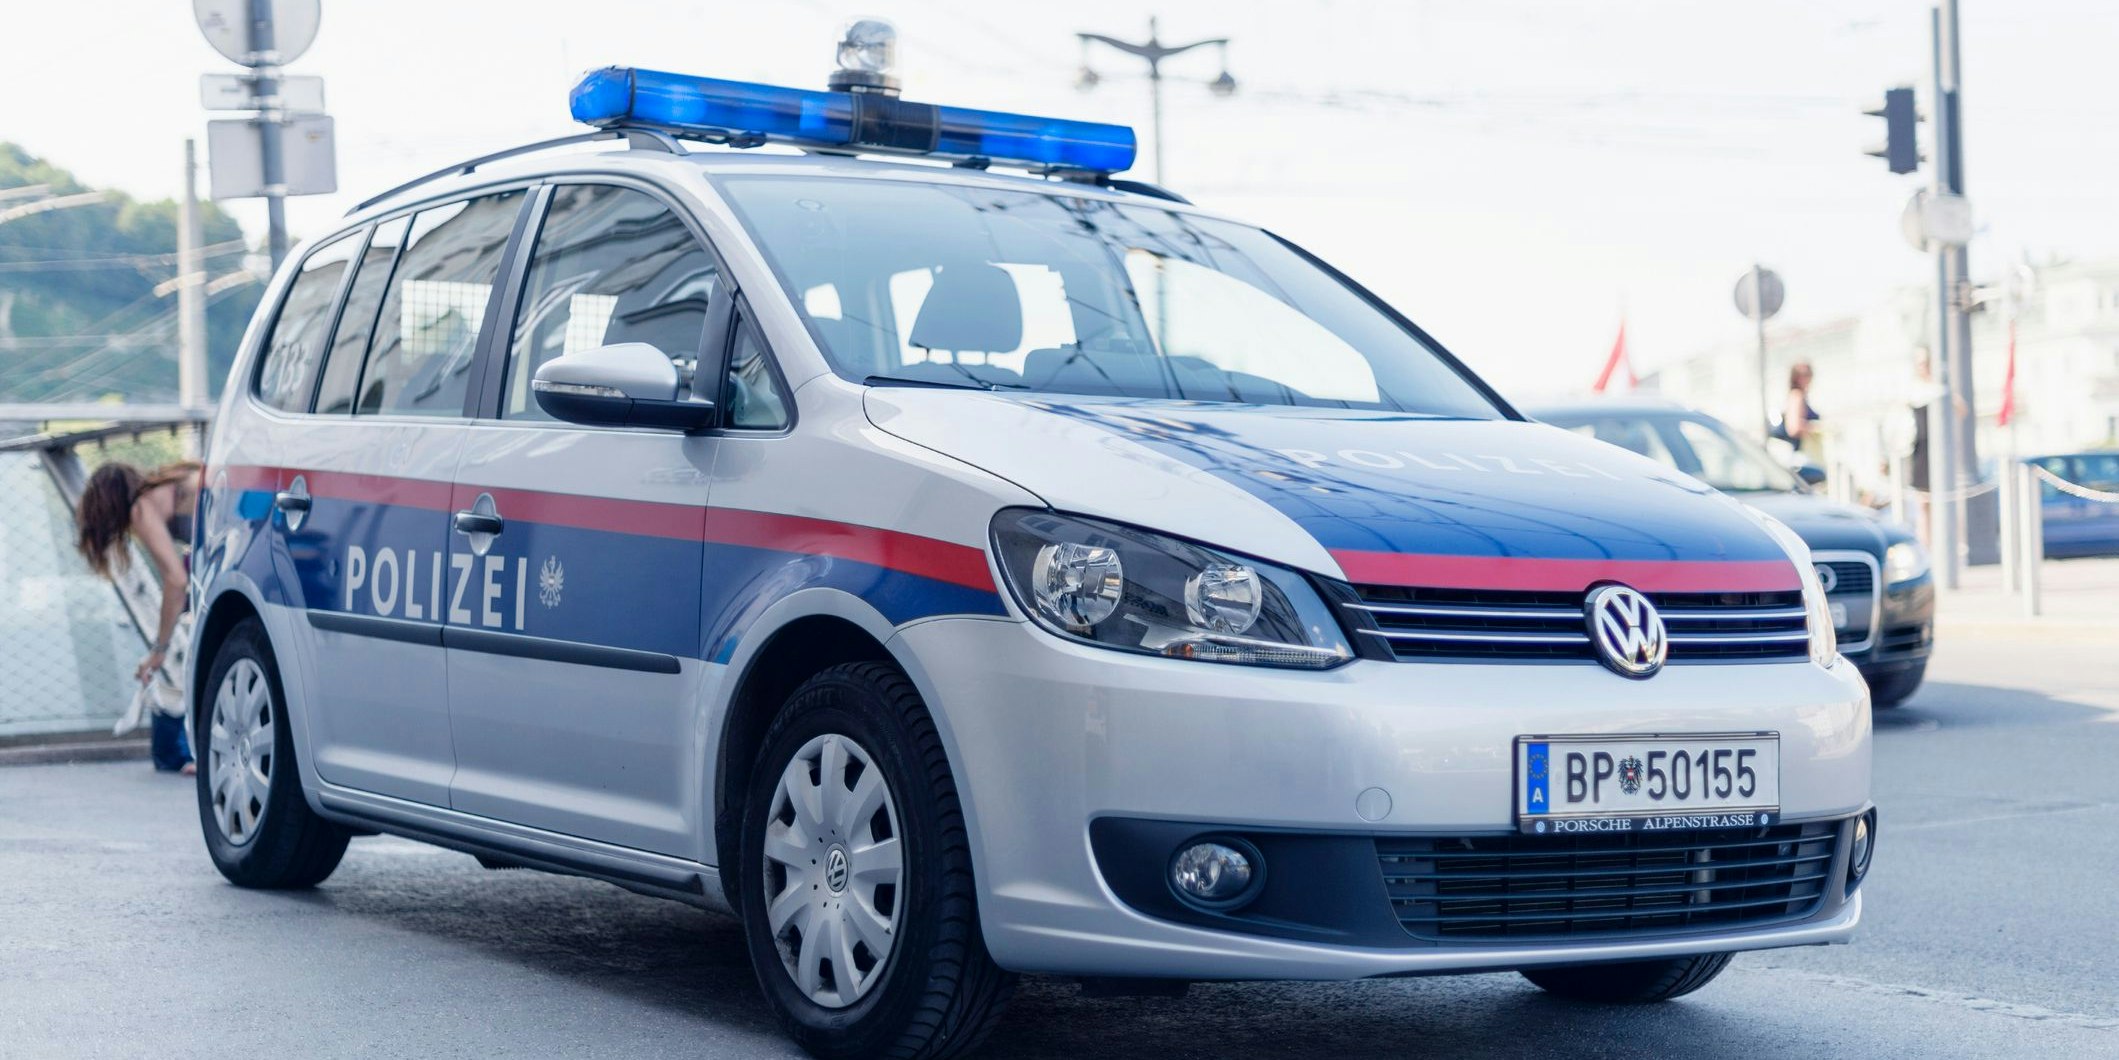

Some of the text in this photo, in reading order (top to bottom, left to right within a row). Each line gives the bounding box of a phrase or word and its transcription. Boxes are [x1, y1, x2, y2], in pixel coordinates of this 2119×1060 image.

[1277, 448, 1624, 481] POLIZEI
[345, 544, 528, 631] POLIZEI
[1597, 588, 1664, 668] VW
[1531, 786, 1545, 804] A
[1566, 748, 1757, 804] BP 50155
[1553, 817, 1632, 834] PORSCHE
[1642, 814, 1755, 831] ALPENSTRASSE
